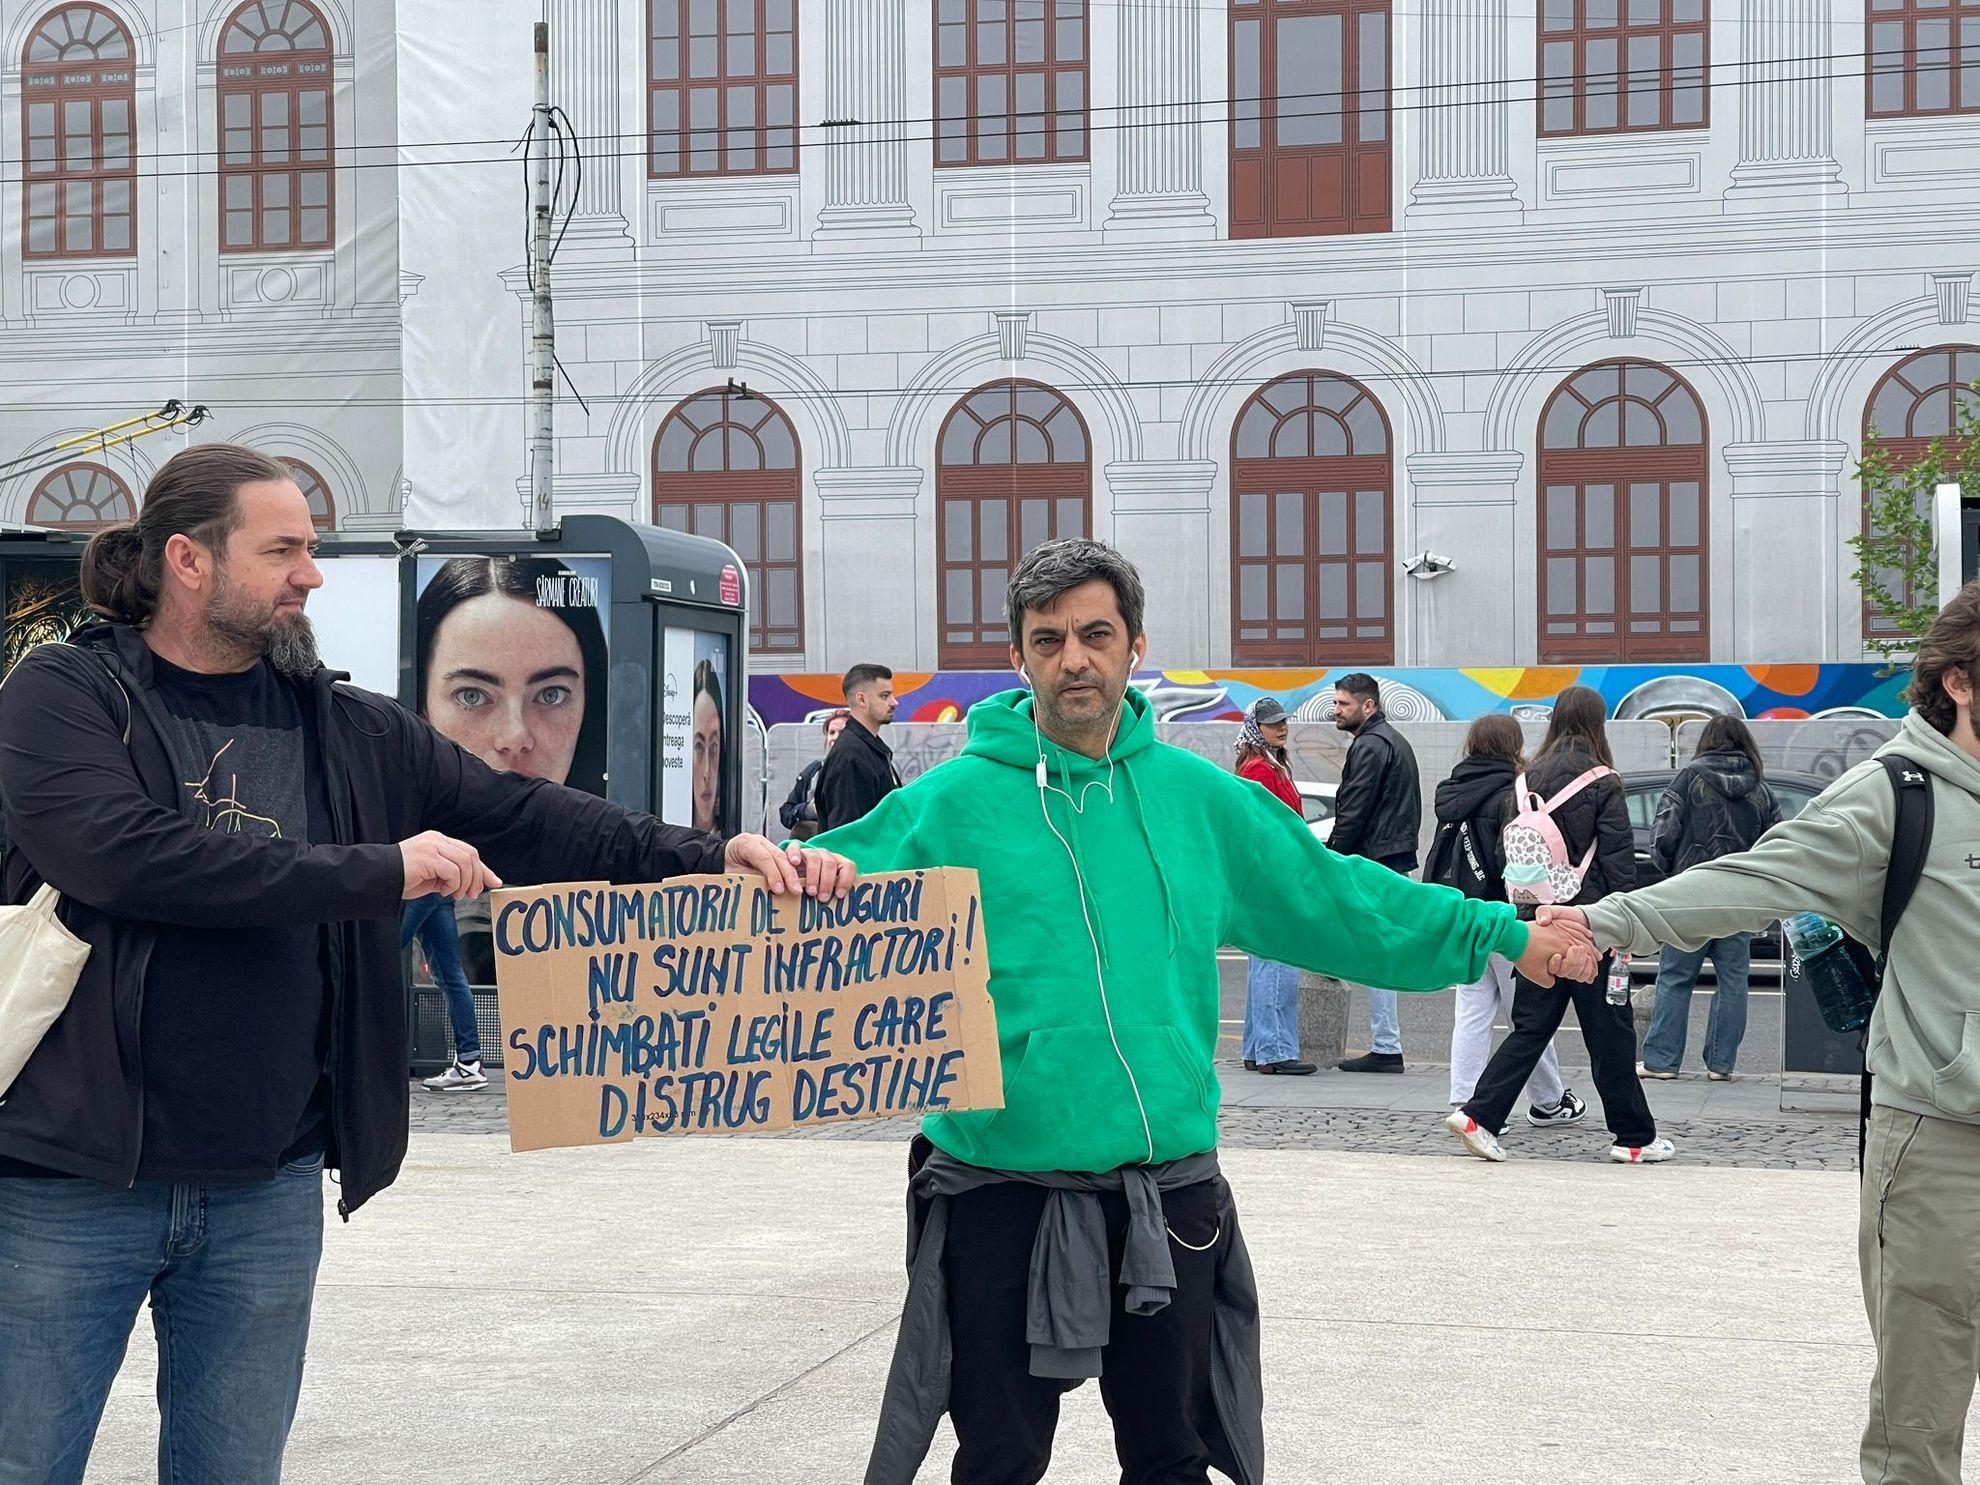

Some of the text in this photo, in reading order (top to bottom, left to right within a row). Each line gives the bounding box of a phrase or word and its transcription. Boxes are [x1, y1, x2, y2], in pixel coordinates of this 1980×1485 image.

[569, 577, 599, 607] CREATURI
[663, 733, 684, 751] ntreaga
[663, 757, 683, 768] oveste
[496, 878, 746, 956] CONSUMATORII
[751, 887, 786, 937] DE
[588, 952, 639, 1009] NU
[653, 944, 752, 998] SUNT
[727, 1002, 835, 1065] LEGILE
[853, 992, 954, 1050] CARE
[599, 1048, 965, 1138] DISTRUG DESTINE
